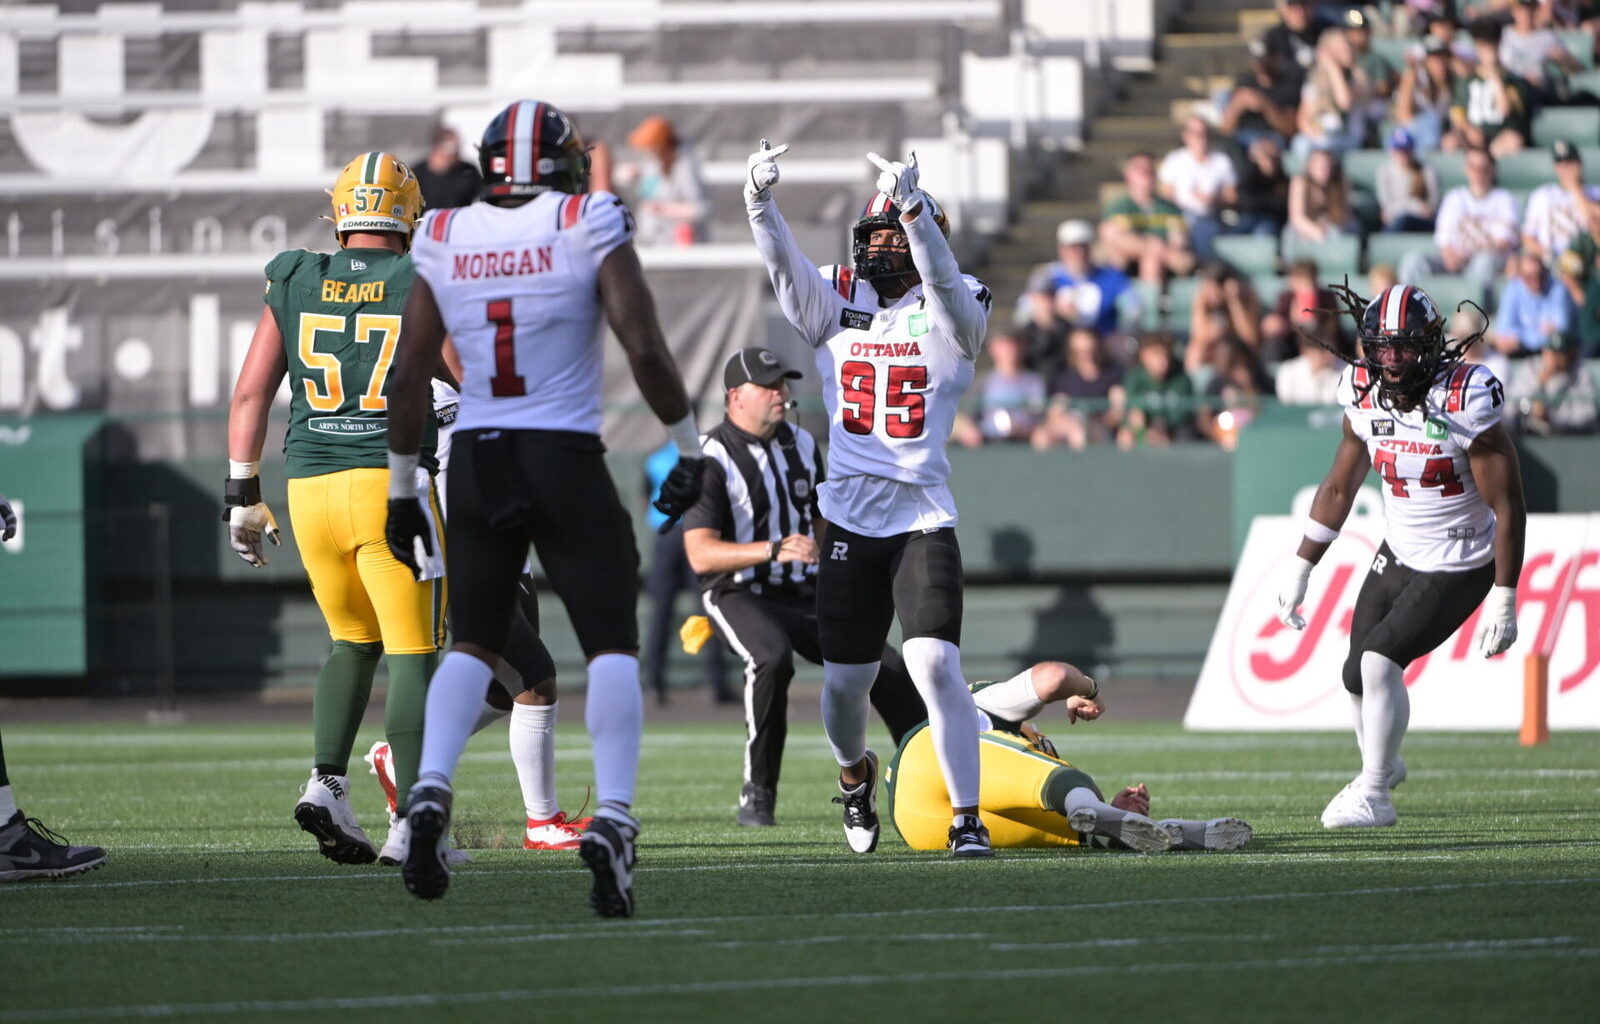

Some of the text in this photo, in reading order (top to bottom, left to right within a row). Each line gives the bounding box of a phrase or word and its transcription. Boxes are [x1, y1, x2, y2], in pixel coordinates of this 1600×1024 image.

[354, 187, 385, 212] 57
[342, 221, 399, 229] EDMONTON
[452, 246, 553, 281] MORGAN
[321, 279, 385, 303] BEARD
[486, 297, 527, 397] 1
[850, 341, 921, 357] OTTAWA
[298, 312, 402, 412] 57
[841, 360, 928, 439] 95
[340, 423, 364, 431] NORTH
[366, 423, 381, 431] INC.
[1380, 440, 1443, 455] OTTAWA
[1371, 448, 1465, 498] 44
[317, 775, 345, 800] NIKE
